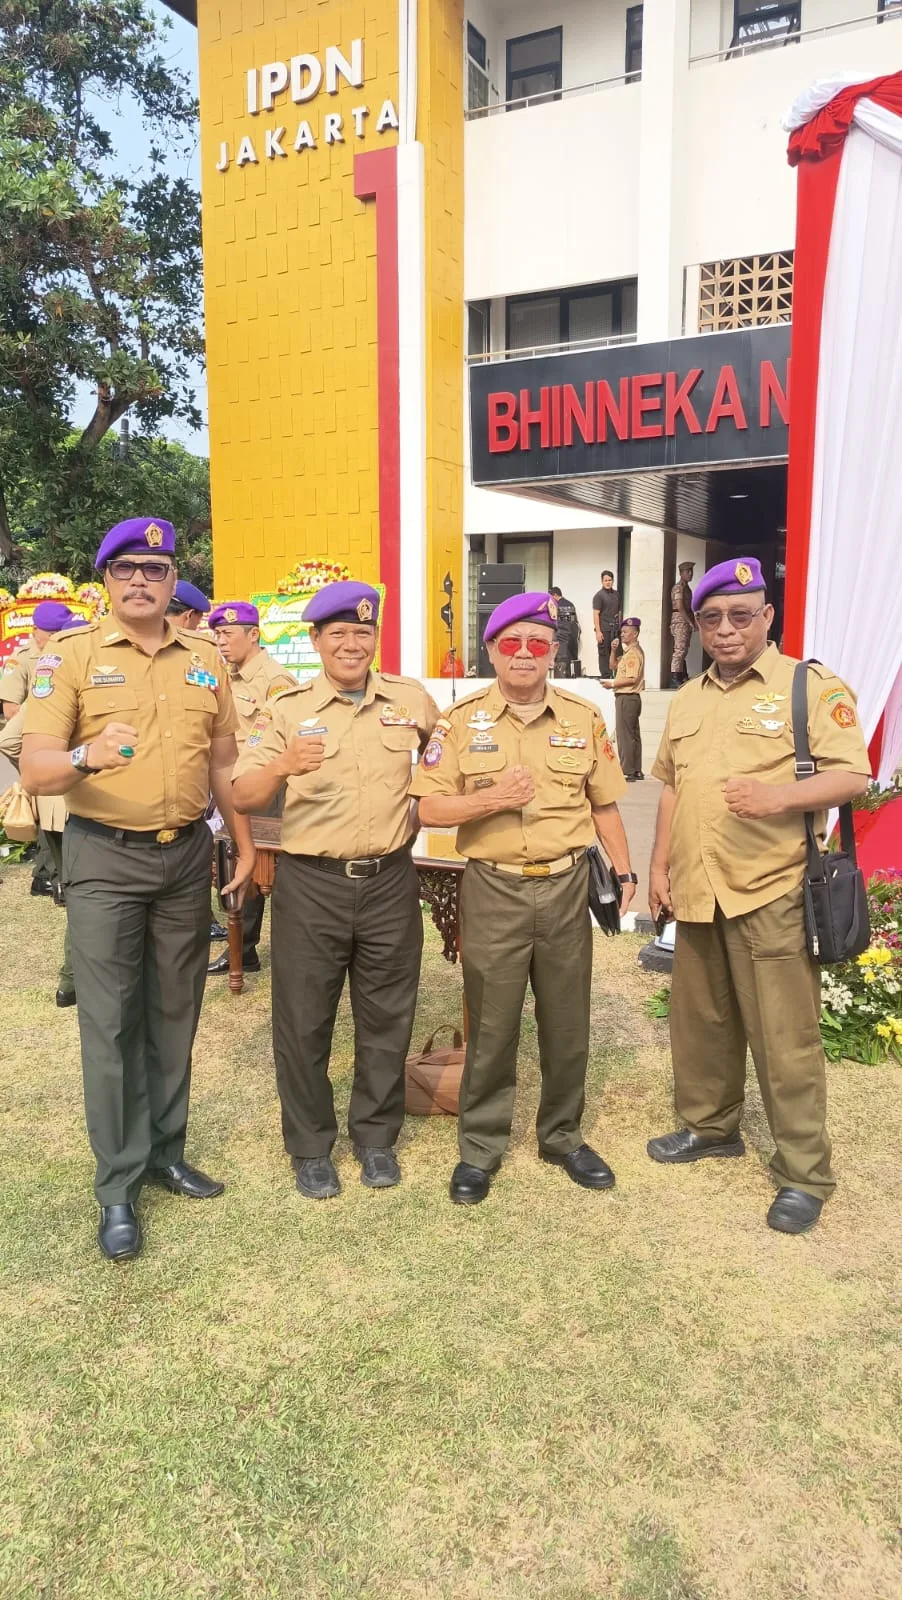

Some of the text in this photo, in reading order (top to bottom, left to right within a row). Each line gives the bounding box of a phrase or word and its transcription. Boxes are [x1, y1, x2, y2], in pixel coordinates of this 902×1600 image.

[247, 38, 363, 115] IPDN
[216, 99, 399, 171] JAKARTA
[487, 367, 748, 453] BHINNEKA
